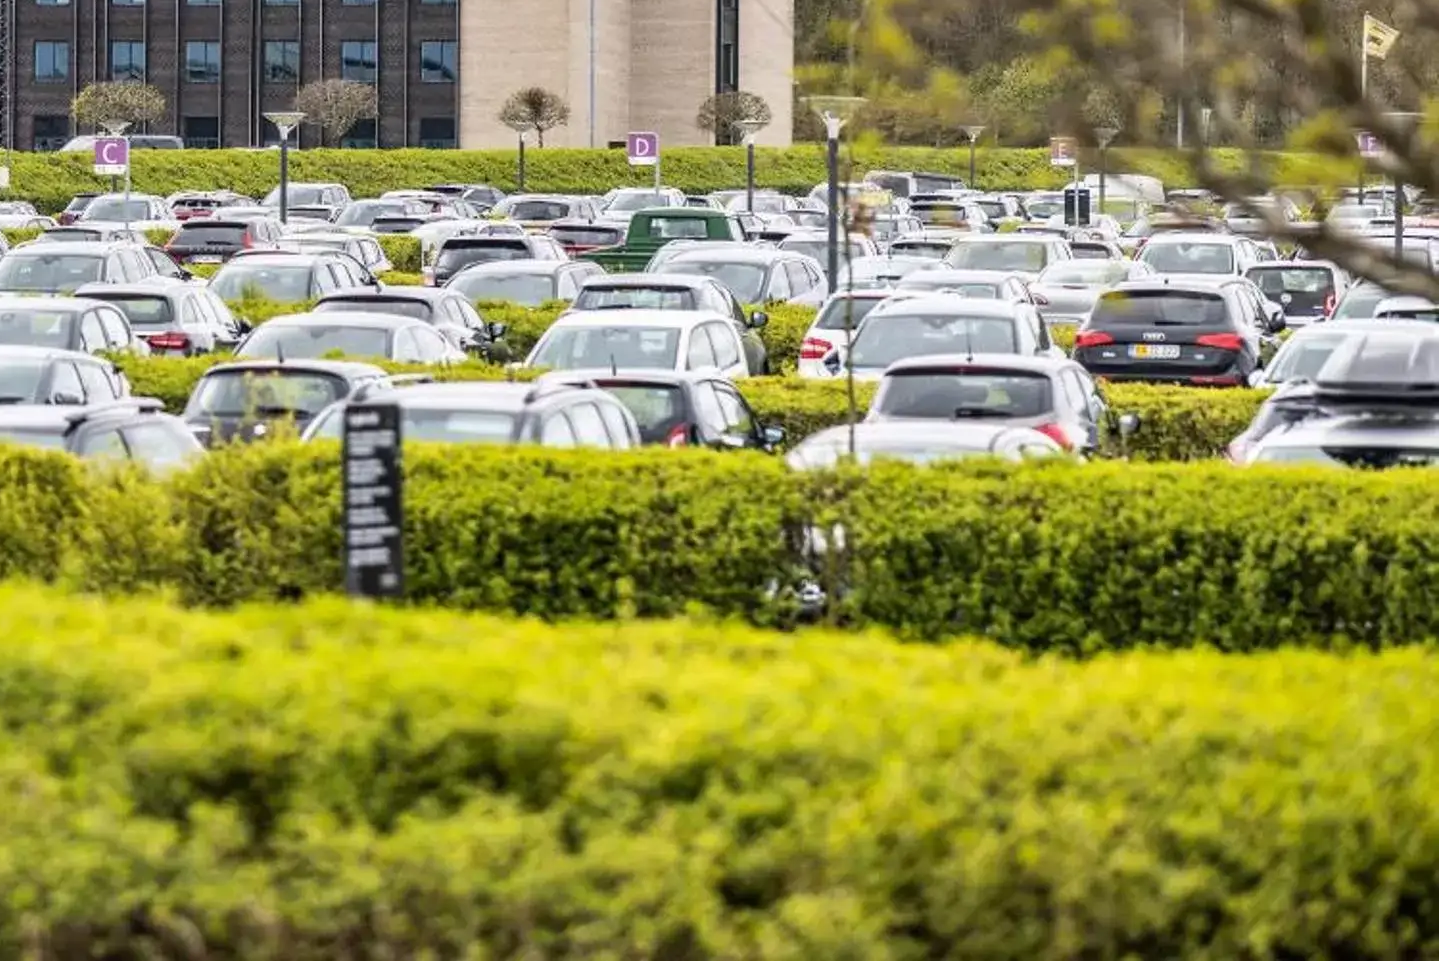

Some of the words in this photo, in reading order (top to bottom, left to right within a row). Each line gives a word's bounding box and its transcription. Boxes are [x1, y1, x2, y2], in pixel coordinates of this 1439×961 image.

[102, 143, 118, 164] C
[635, 137, 649, 156] D
[1058, 143, 1068, 158] E
